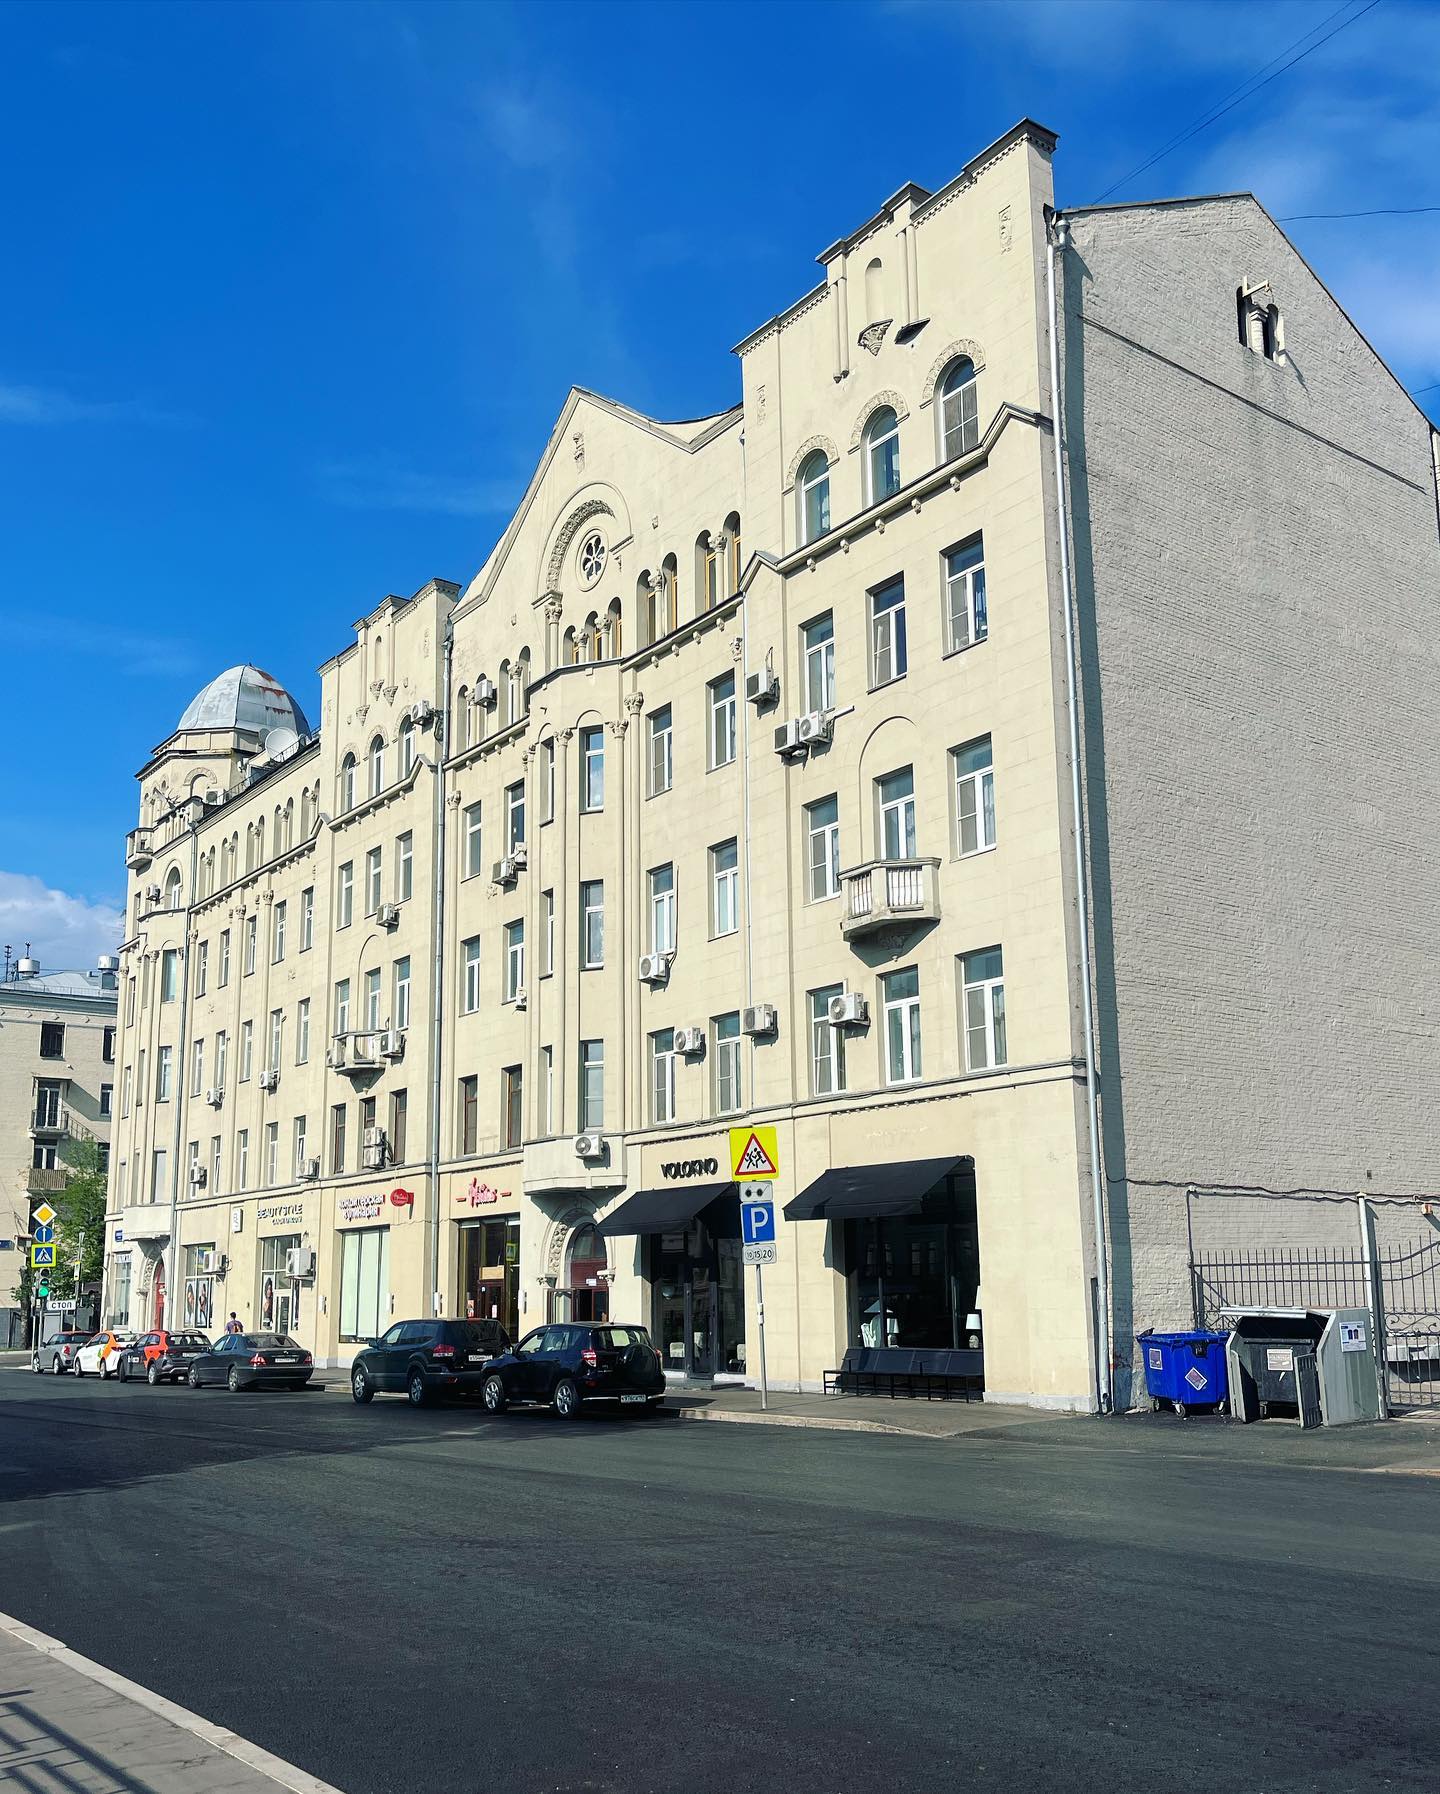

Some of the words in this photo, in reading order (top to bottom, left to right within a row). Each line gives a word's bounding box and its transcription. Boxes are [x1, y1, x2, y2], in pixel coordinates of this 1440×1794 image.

[660, 1158, 718, 1179] VOLOKNO
[750, 1206, 769, 1239] P
[762, 1249, 772, 1258] 20
[51, 1301, 72, 1309] СТОП
